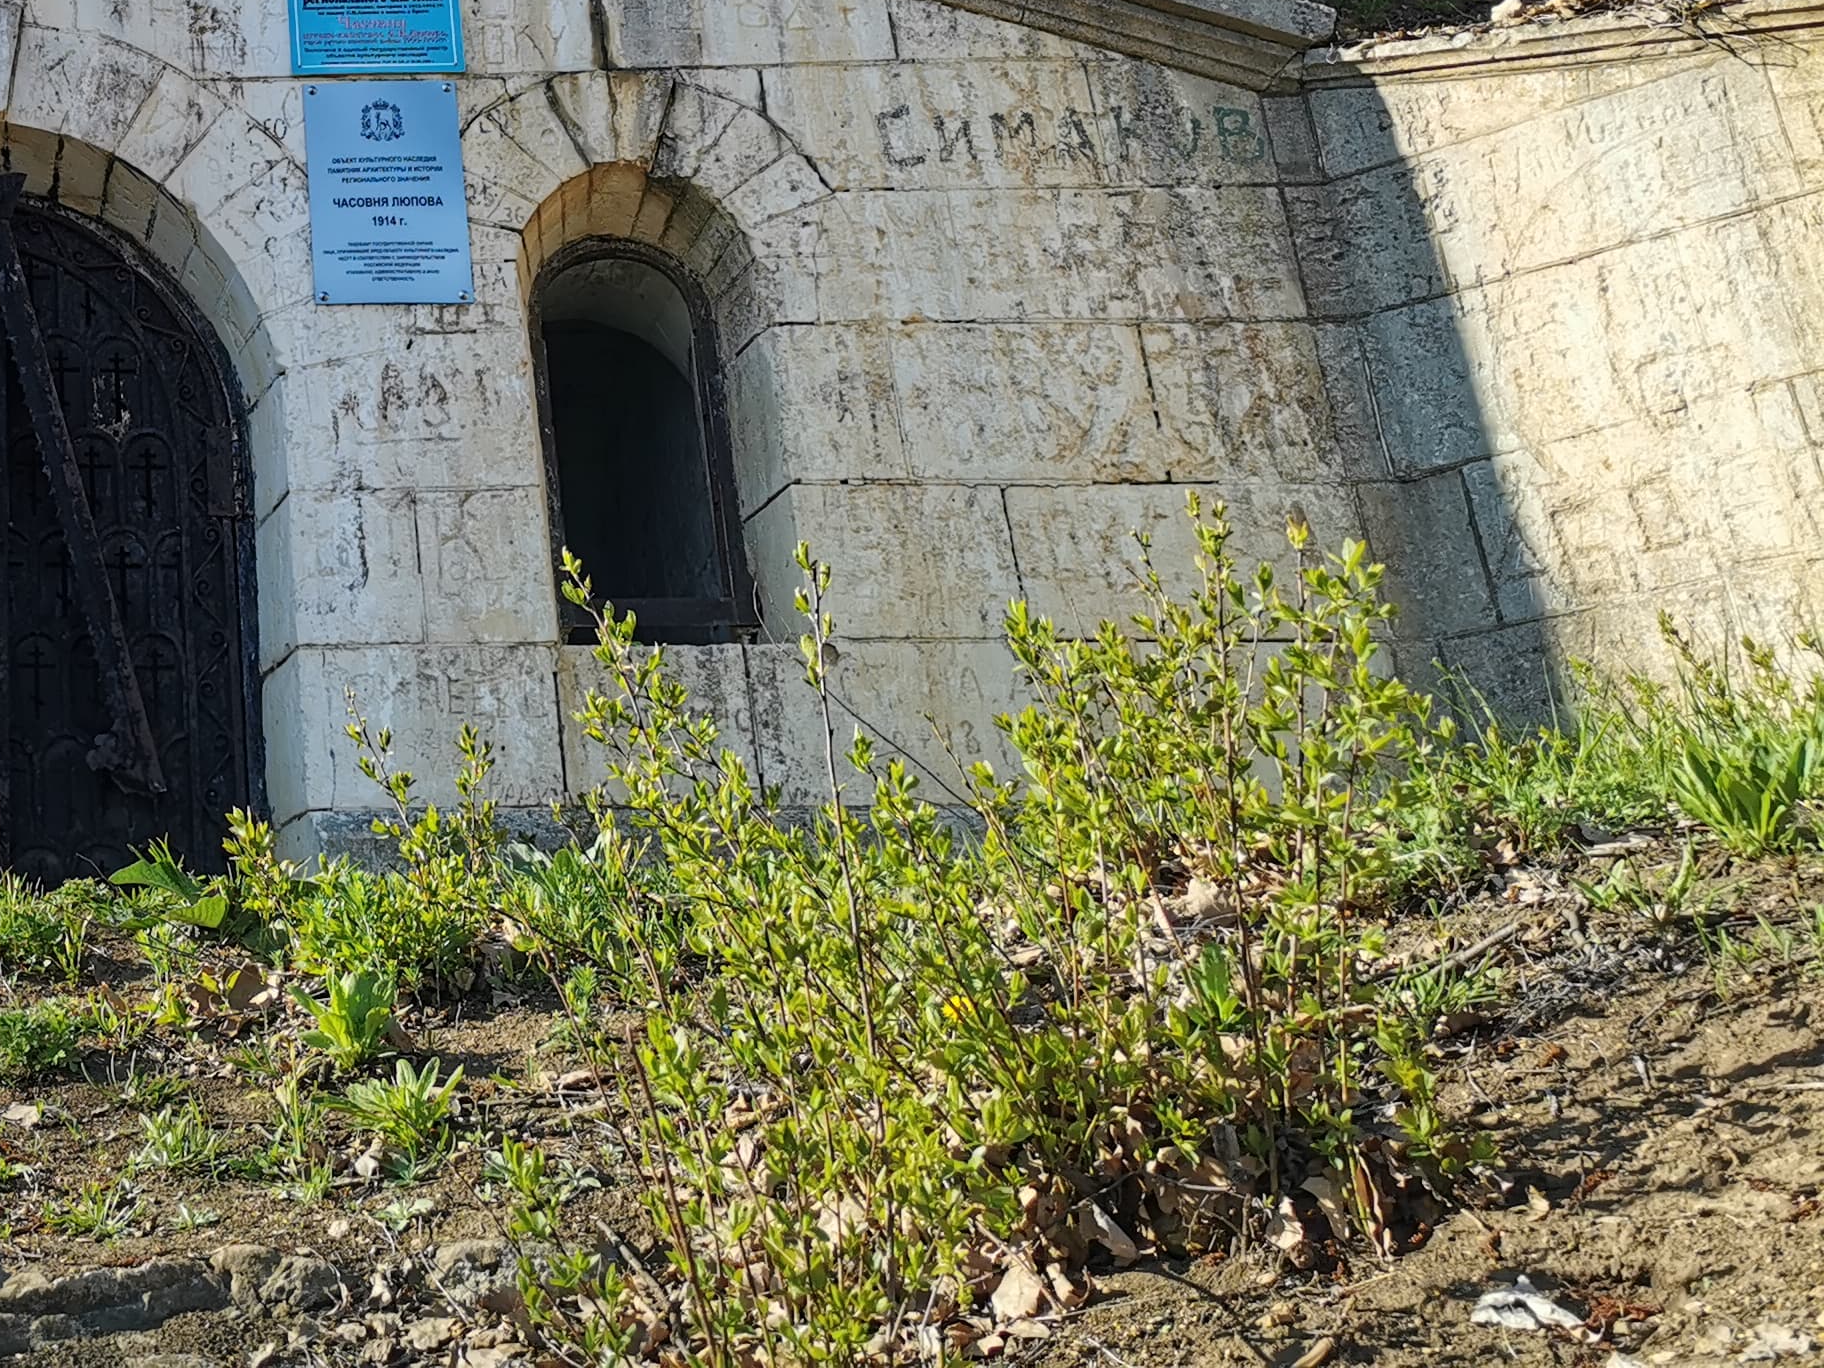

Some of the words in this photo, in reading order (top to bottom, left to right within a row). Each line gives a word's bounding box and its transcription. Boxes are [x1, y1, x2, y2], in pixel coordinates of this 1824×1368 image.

[333, 197, 389, 208] ЧАСОВНЯ
[392, 196, 444, 207] ЛЮПОВА
[372, 216, 396, 226] 1914
[399, 218, 407, 226] г.
